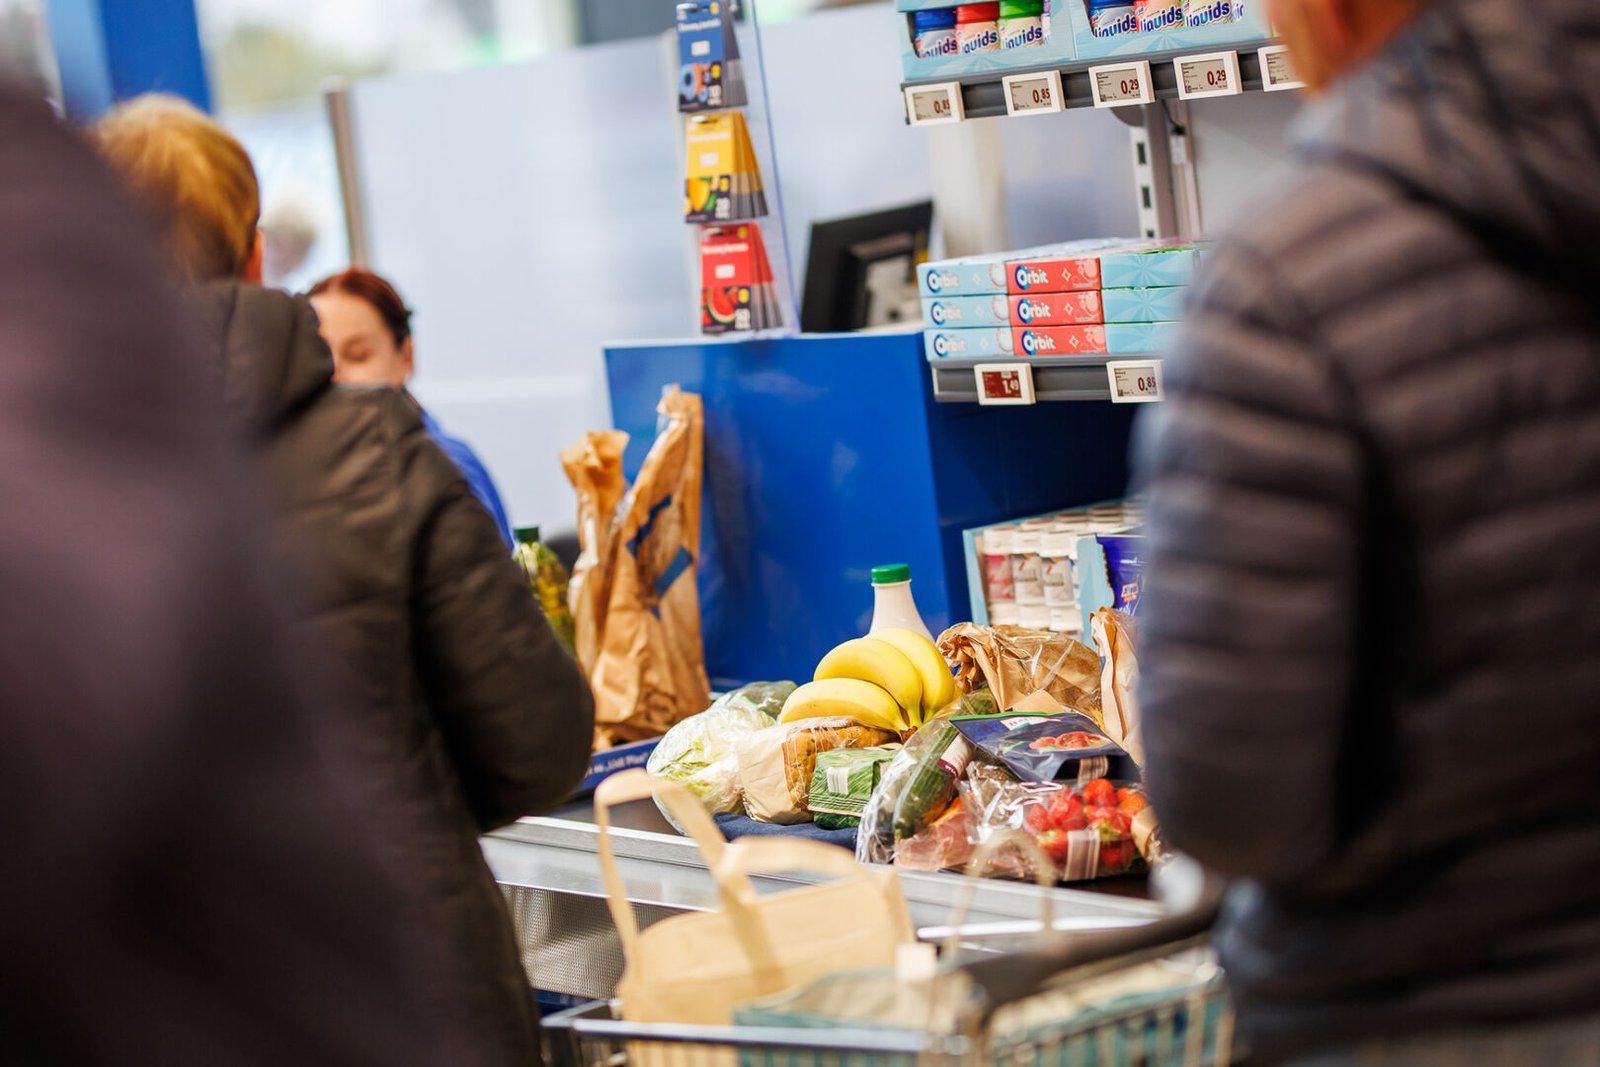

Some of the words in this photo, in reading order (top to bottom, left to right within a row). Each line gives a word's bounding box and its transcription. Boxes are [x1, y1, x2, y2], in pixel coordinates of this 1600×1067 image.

[1120, 78, 1139, 95] 0.29
[1207, 69, 1227, 86] 0.29
[927, 269, 959, 293] Orbit
[1015, 265, 1049, 290] Orbit
[931, 302, 962, 326] Orbit
[1018, 299, 1051, 324] Orbit
[934, 334, 966, 358] Orbit
[1022, 331, 1056, 355] Orbit
[1138, 376, 1156, 392] 0.85
